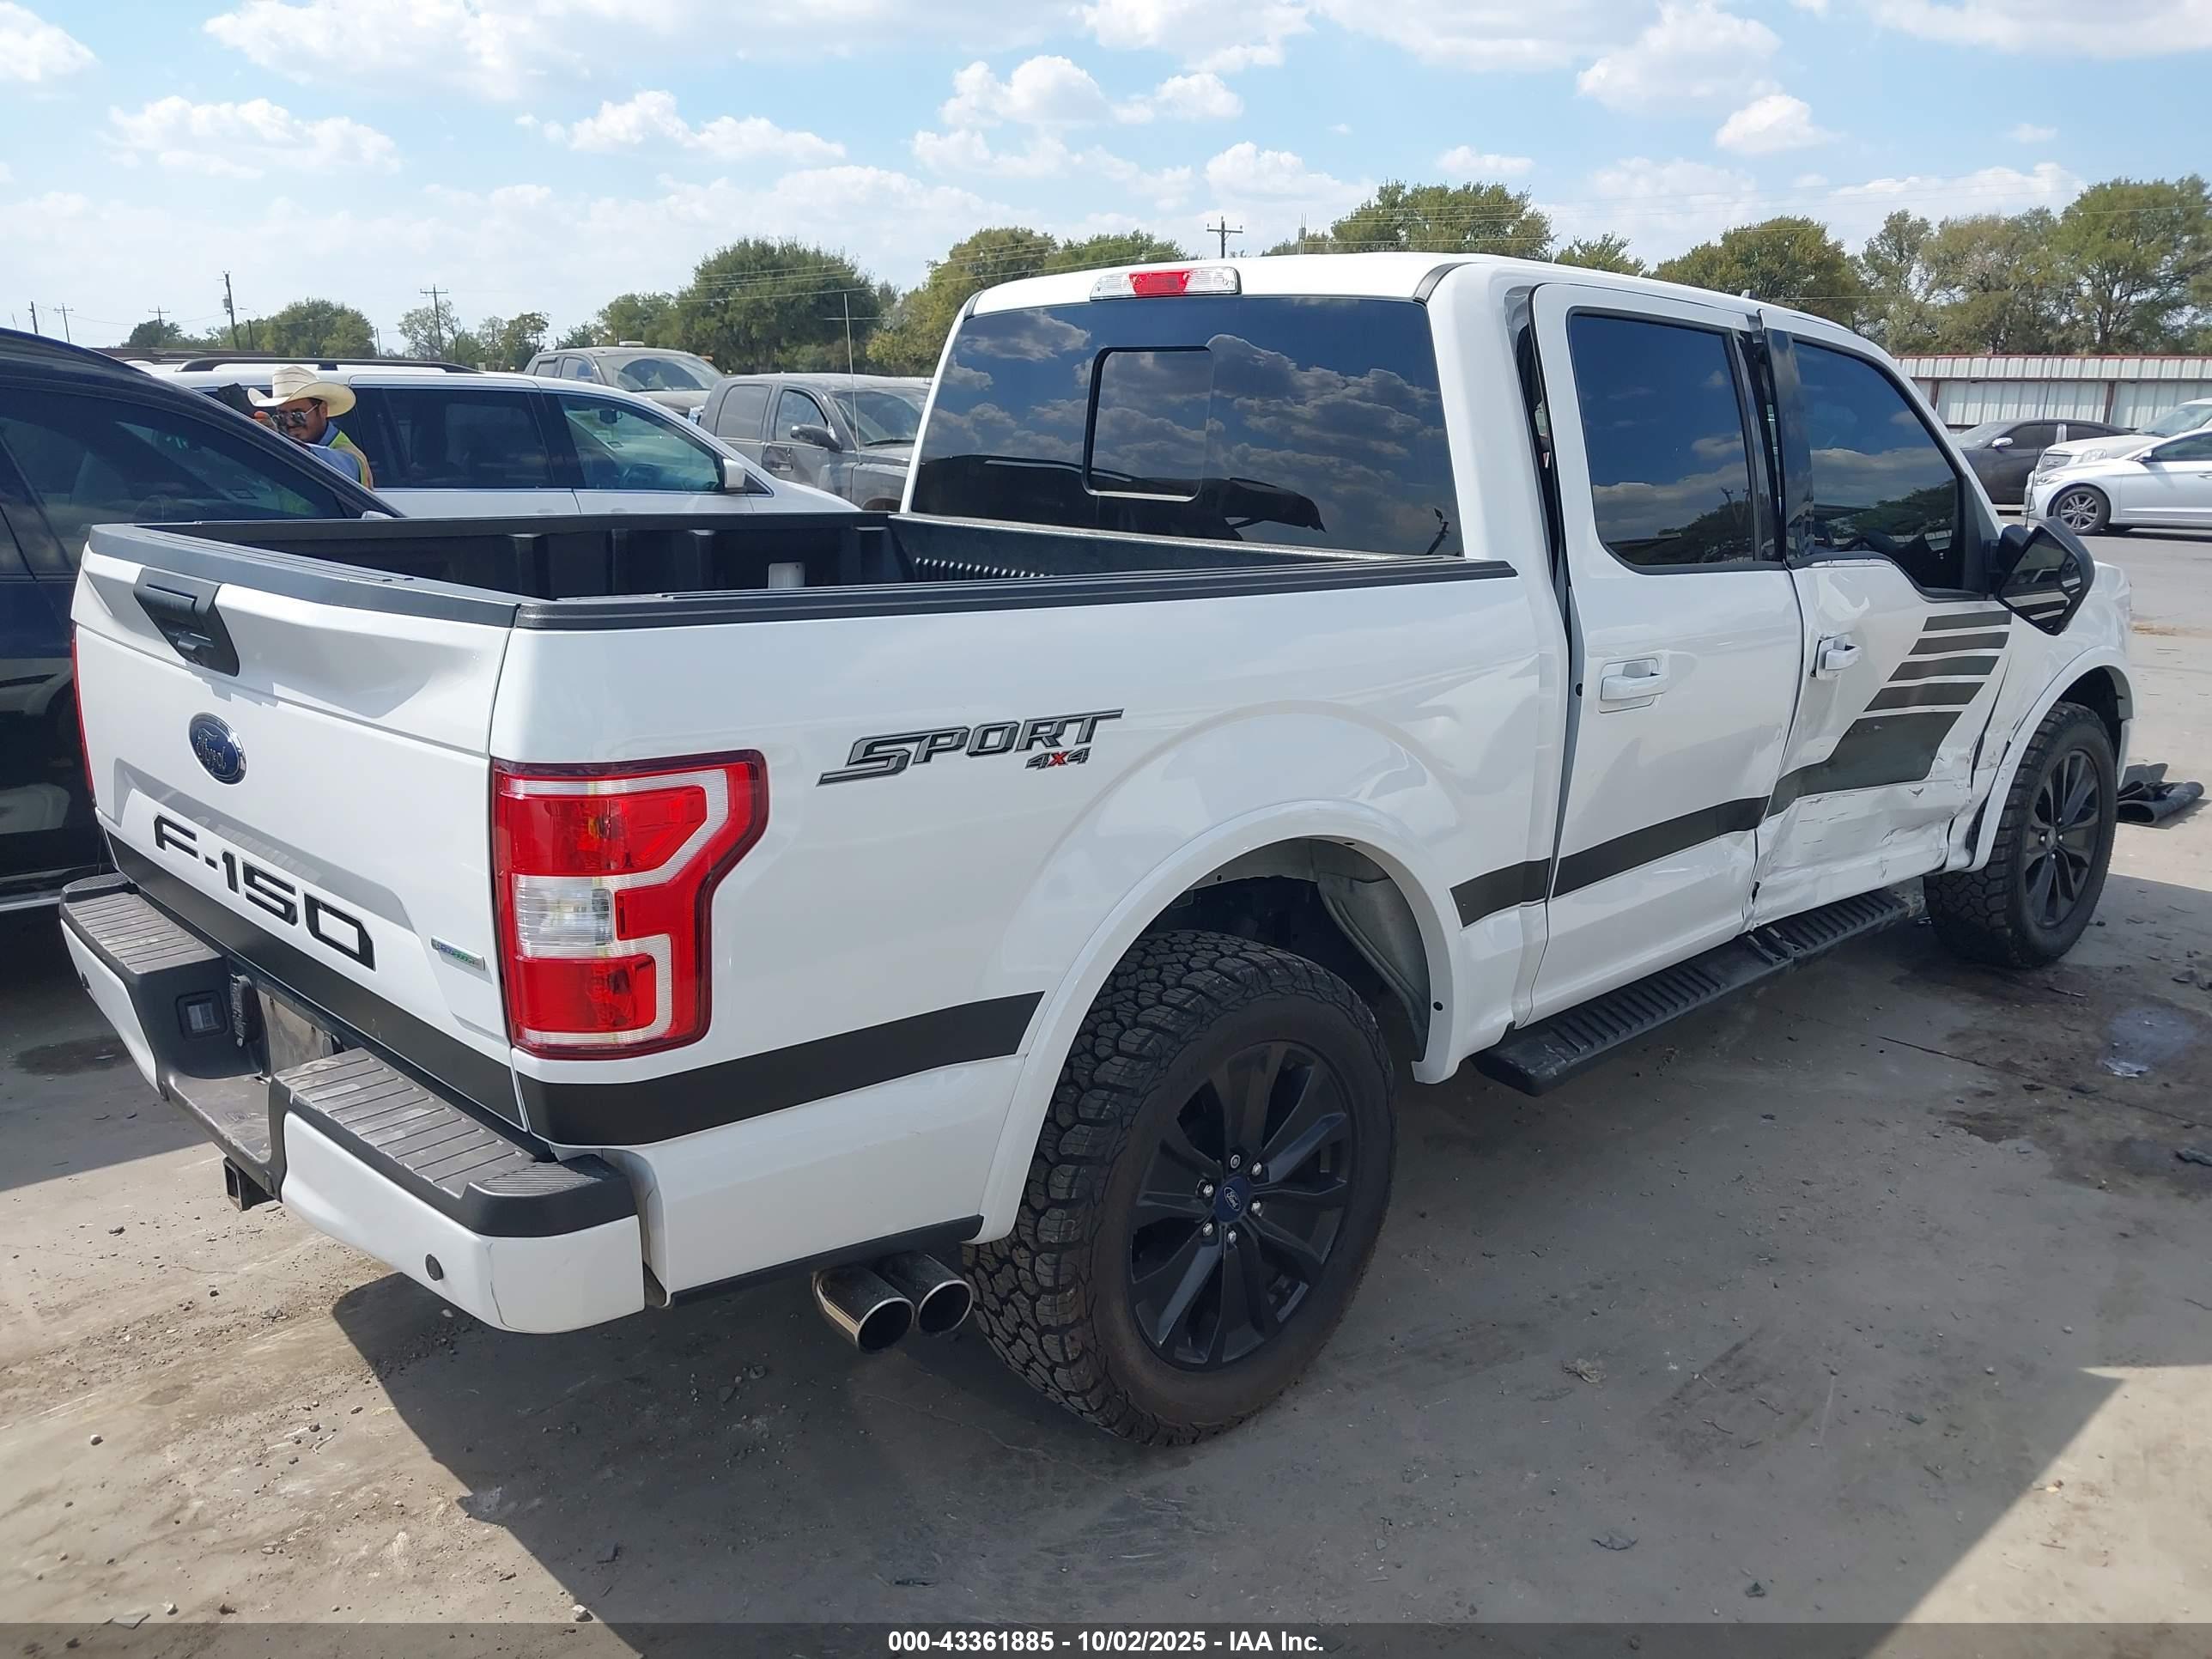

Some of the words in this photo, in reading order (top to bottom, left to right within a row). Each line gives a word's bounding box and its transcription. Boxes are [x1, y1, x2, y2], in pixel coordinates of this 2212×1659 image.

[196, 726, 228, 771] Ford
[816, 708, 1125, 787] SPORT
[153, 812, 376, 972] F-150
[1226, 1191, 1238, 1208] Ford
